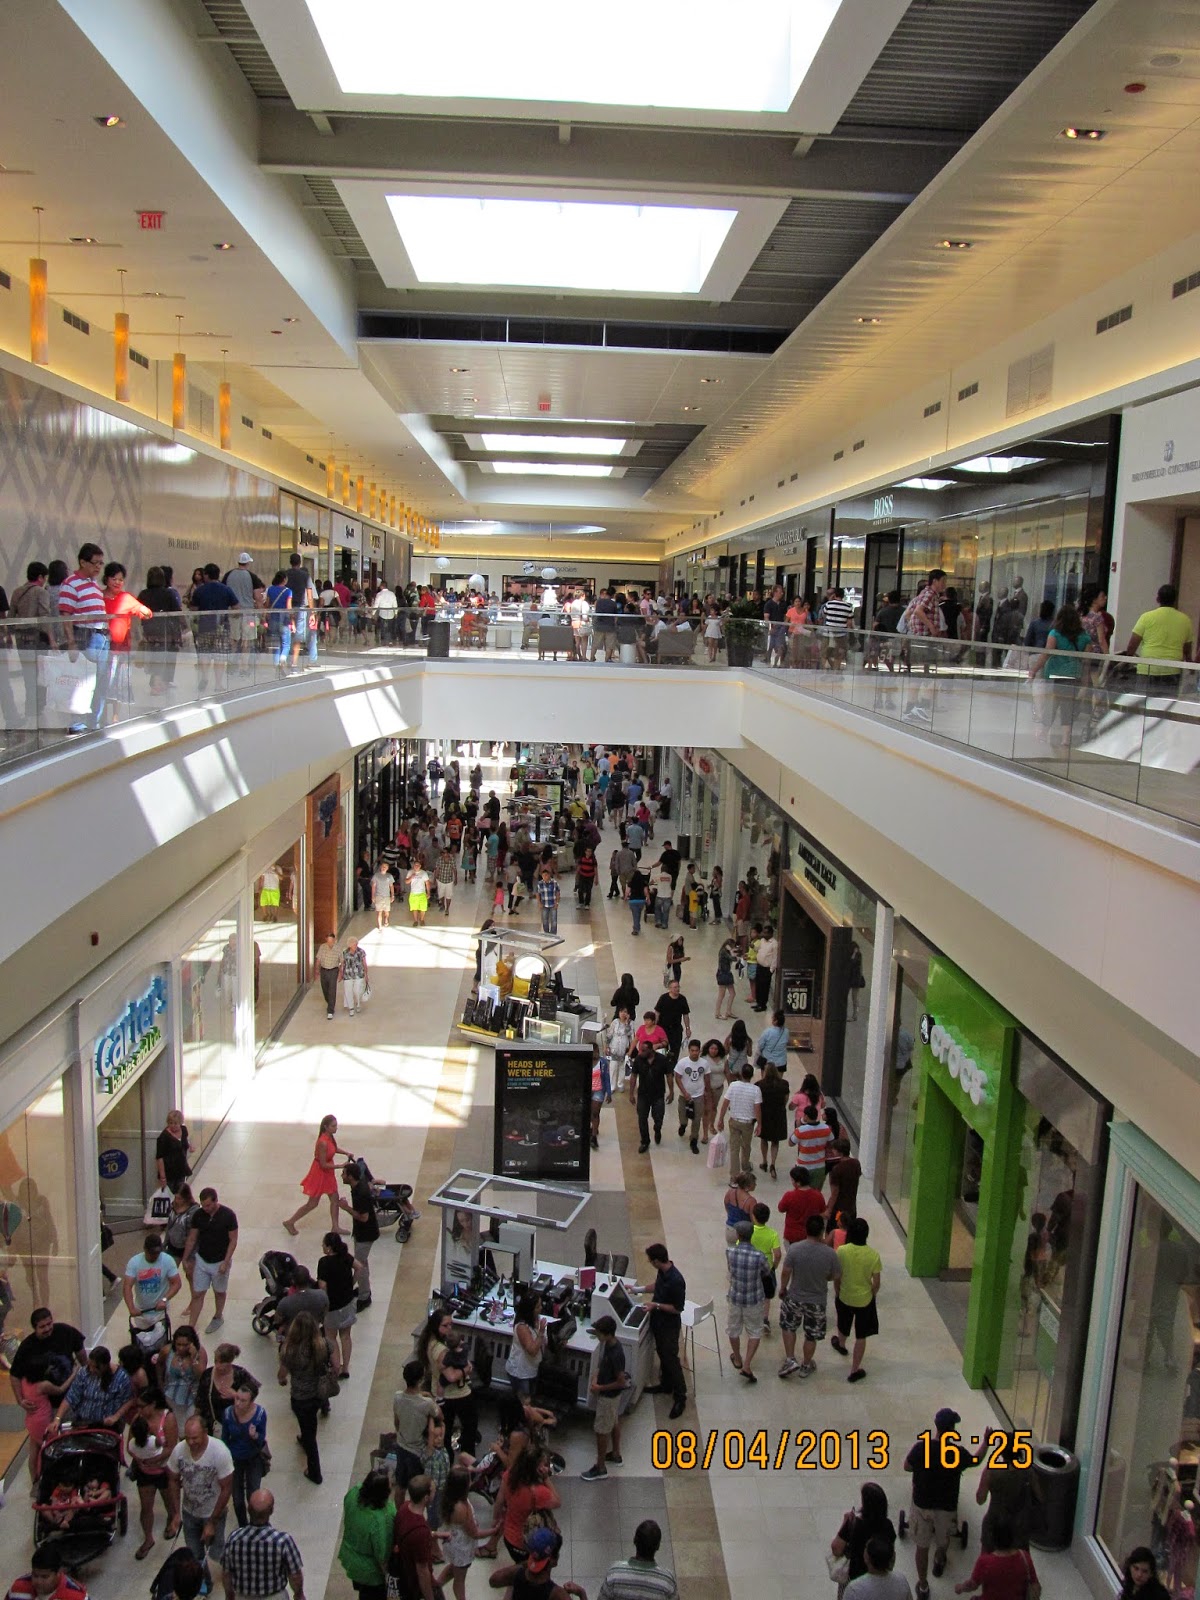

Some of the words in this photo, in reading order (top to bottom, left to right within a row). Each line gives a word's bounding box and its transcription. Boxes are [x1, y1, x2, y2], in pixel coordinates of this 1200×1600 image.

[141, 213, 162, 229] EXIT
[873, 494, 893, 518] BOSS
[787, 992, 807, 1010] $30
[96, 975, 168, 1078] carter's
[507, 1060, 533, 1069] HEADS
[535, 1060, 548, 1069] UP.
[507, 1069, 532, 1077] WE'RE
[533, 1069, 556, 1077] HERE.
[930, 1024, 988, 1106] crocs
